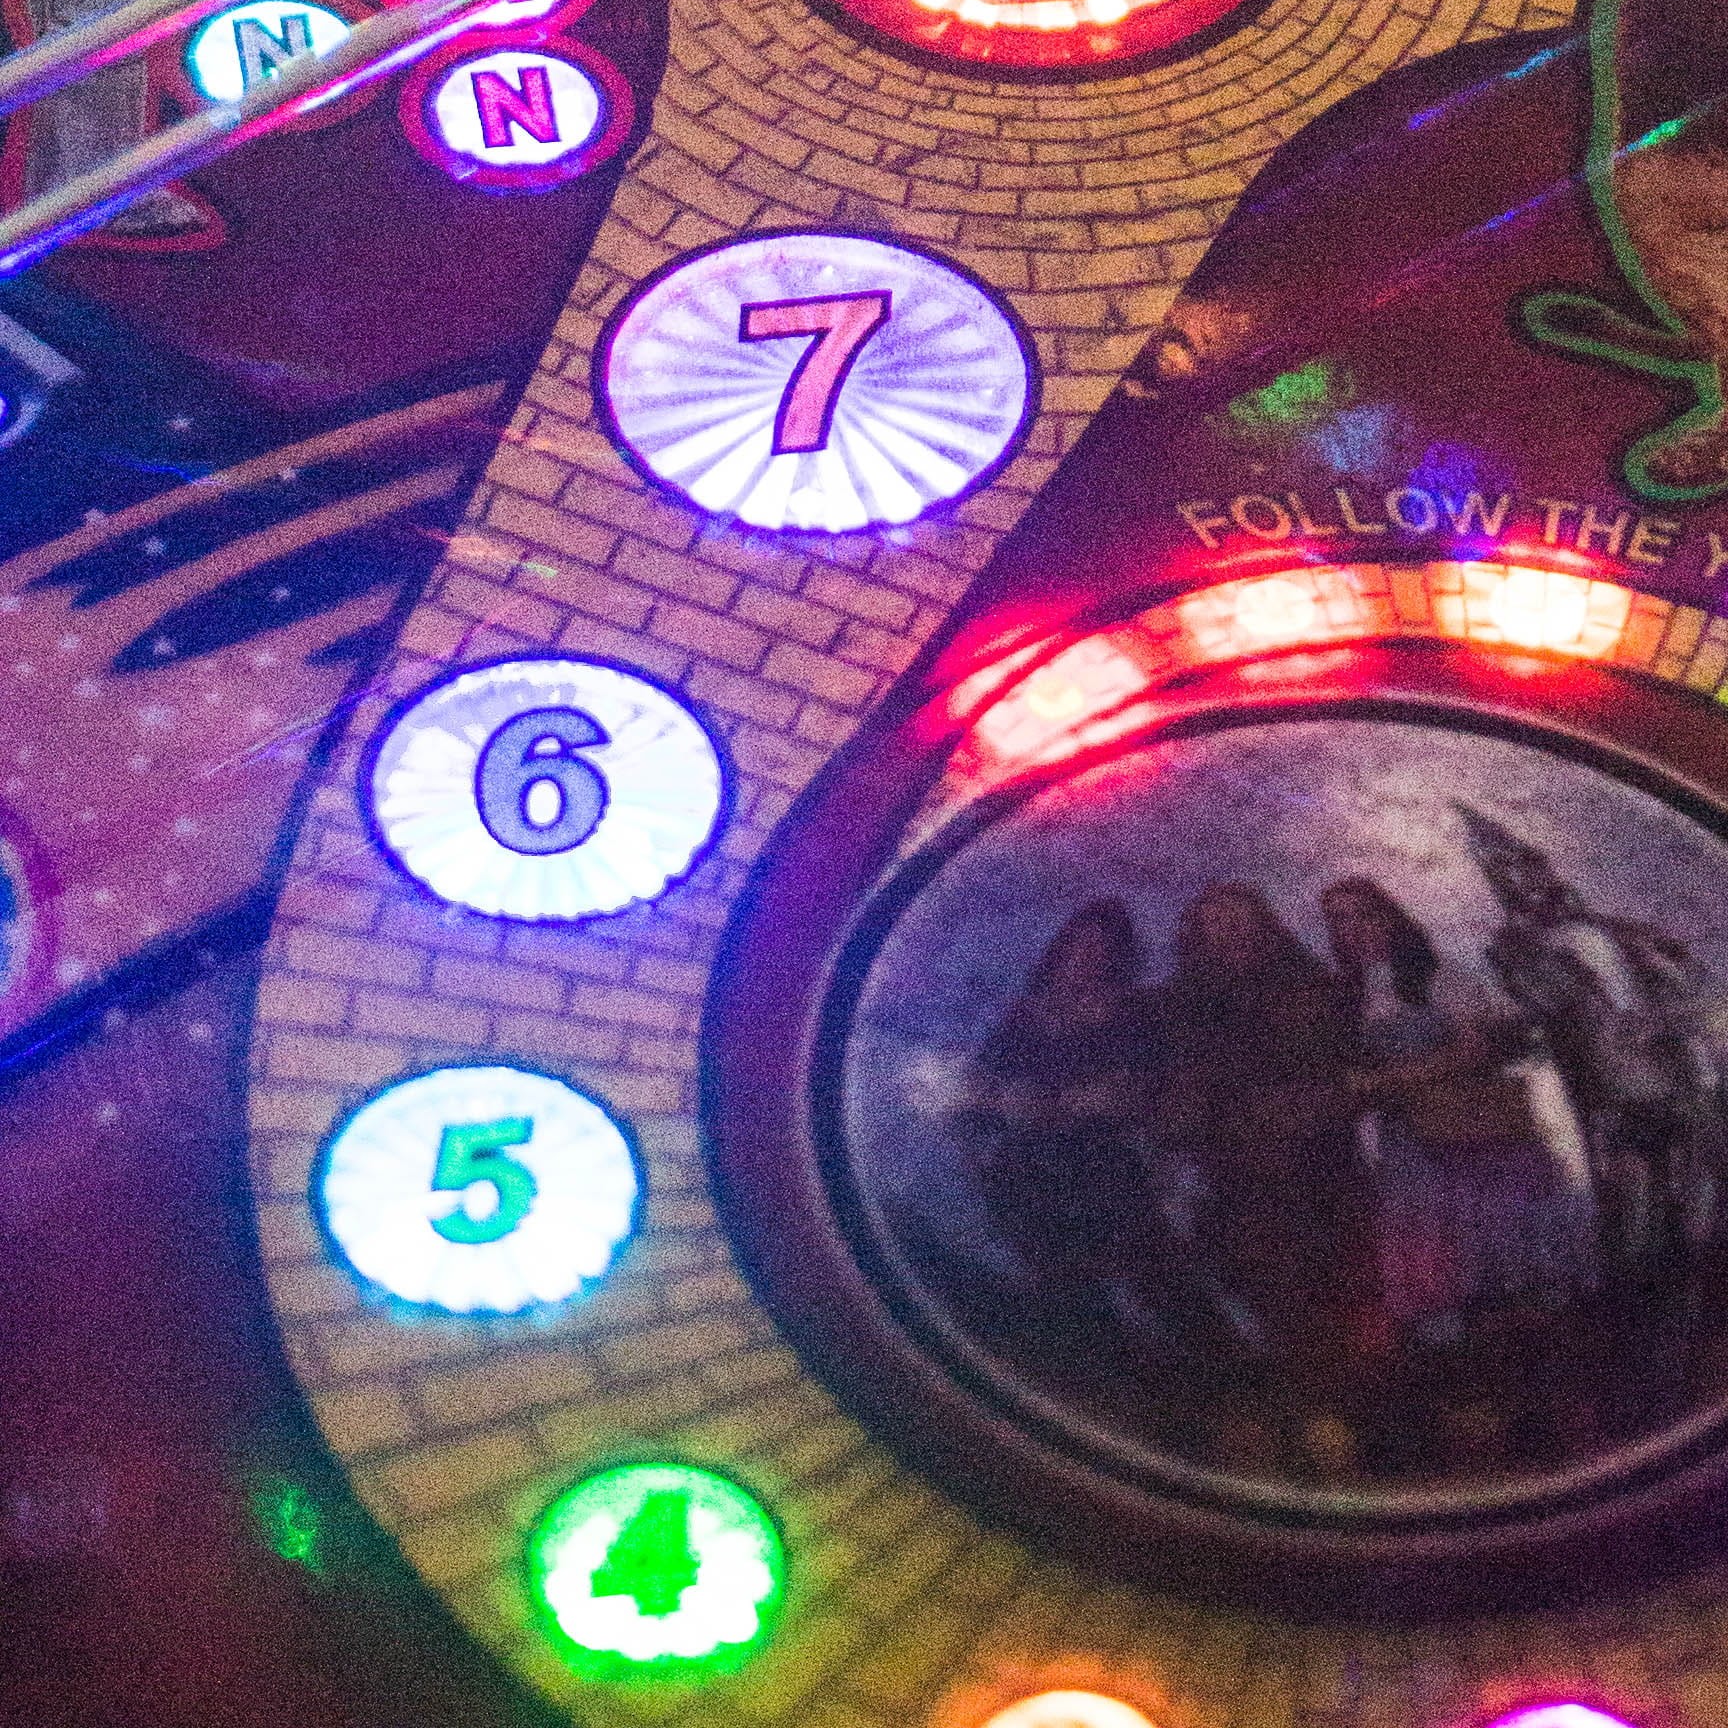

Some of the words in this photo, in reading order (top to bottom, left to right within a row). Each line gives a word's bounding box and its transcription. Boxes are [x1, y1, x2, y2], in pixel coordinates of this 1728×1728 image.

[738, 289, 893, 456] 7
[1176, 486, 1511, 548] FOLLOW
[1536, 496, 1682, 565] THE
[474, 706, 612, 856] 6
[428, 1115, 538, 1245] 5
[590, 1490, 702, 1620] 4
